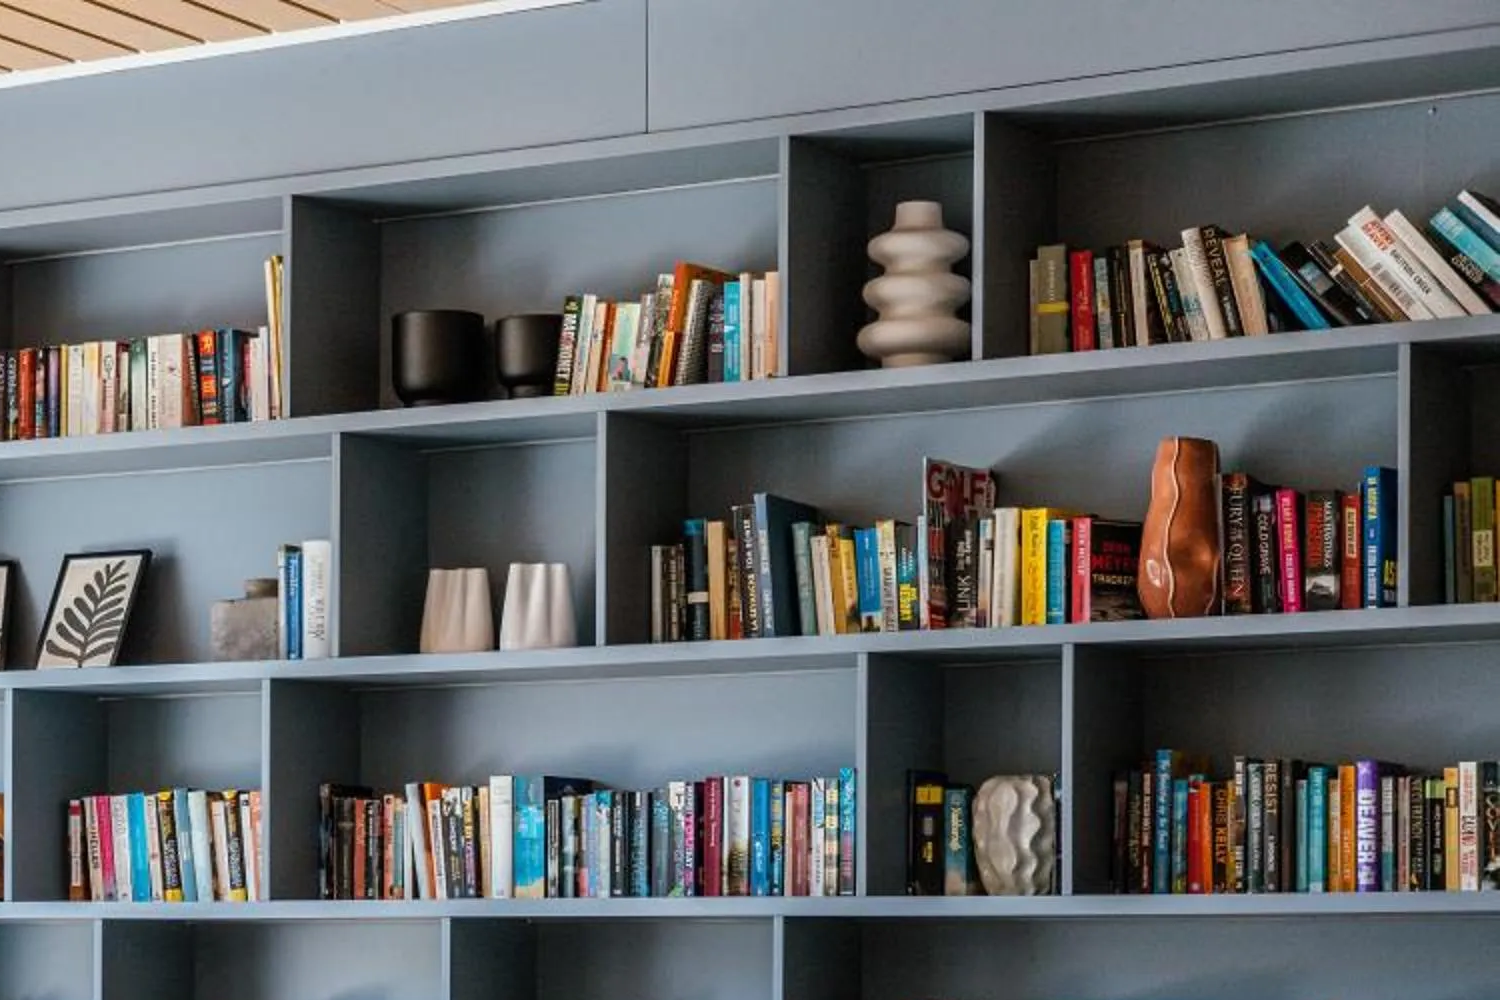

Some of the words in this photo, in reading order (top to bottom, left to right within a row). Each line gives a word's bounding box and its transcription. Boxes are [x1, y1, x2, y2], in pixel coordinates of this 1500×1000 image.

[1203, 228, 1227, 287] REVEAL
[1229, 486, 1244, 525] FURY
[1258, 514, 1268, 540] COLD
[1259, 541, 1270, 576] GRAVE
[956, 575, 971, 611] LINK
[1264, 762, 1277, 815] RESIST
[1214, 827, 1227, 864] KELLY
[1358, 791, 1377, 863] DEAVER
